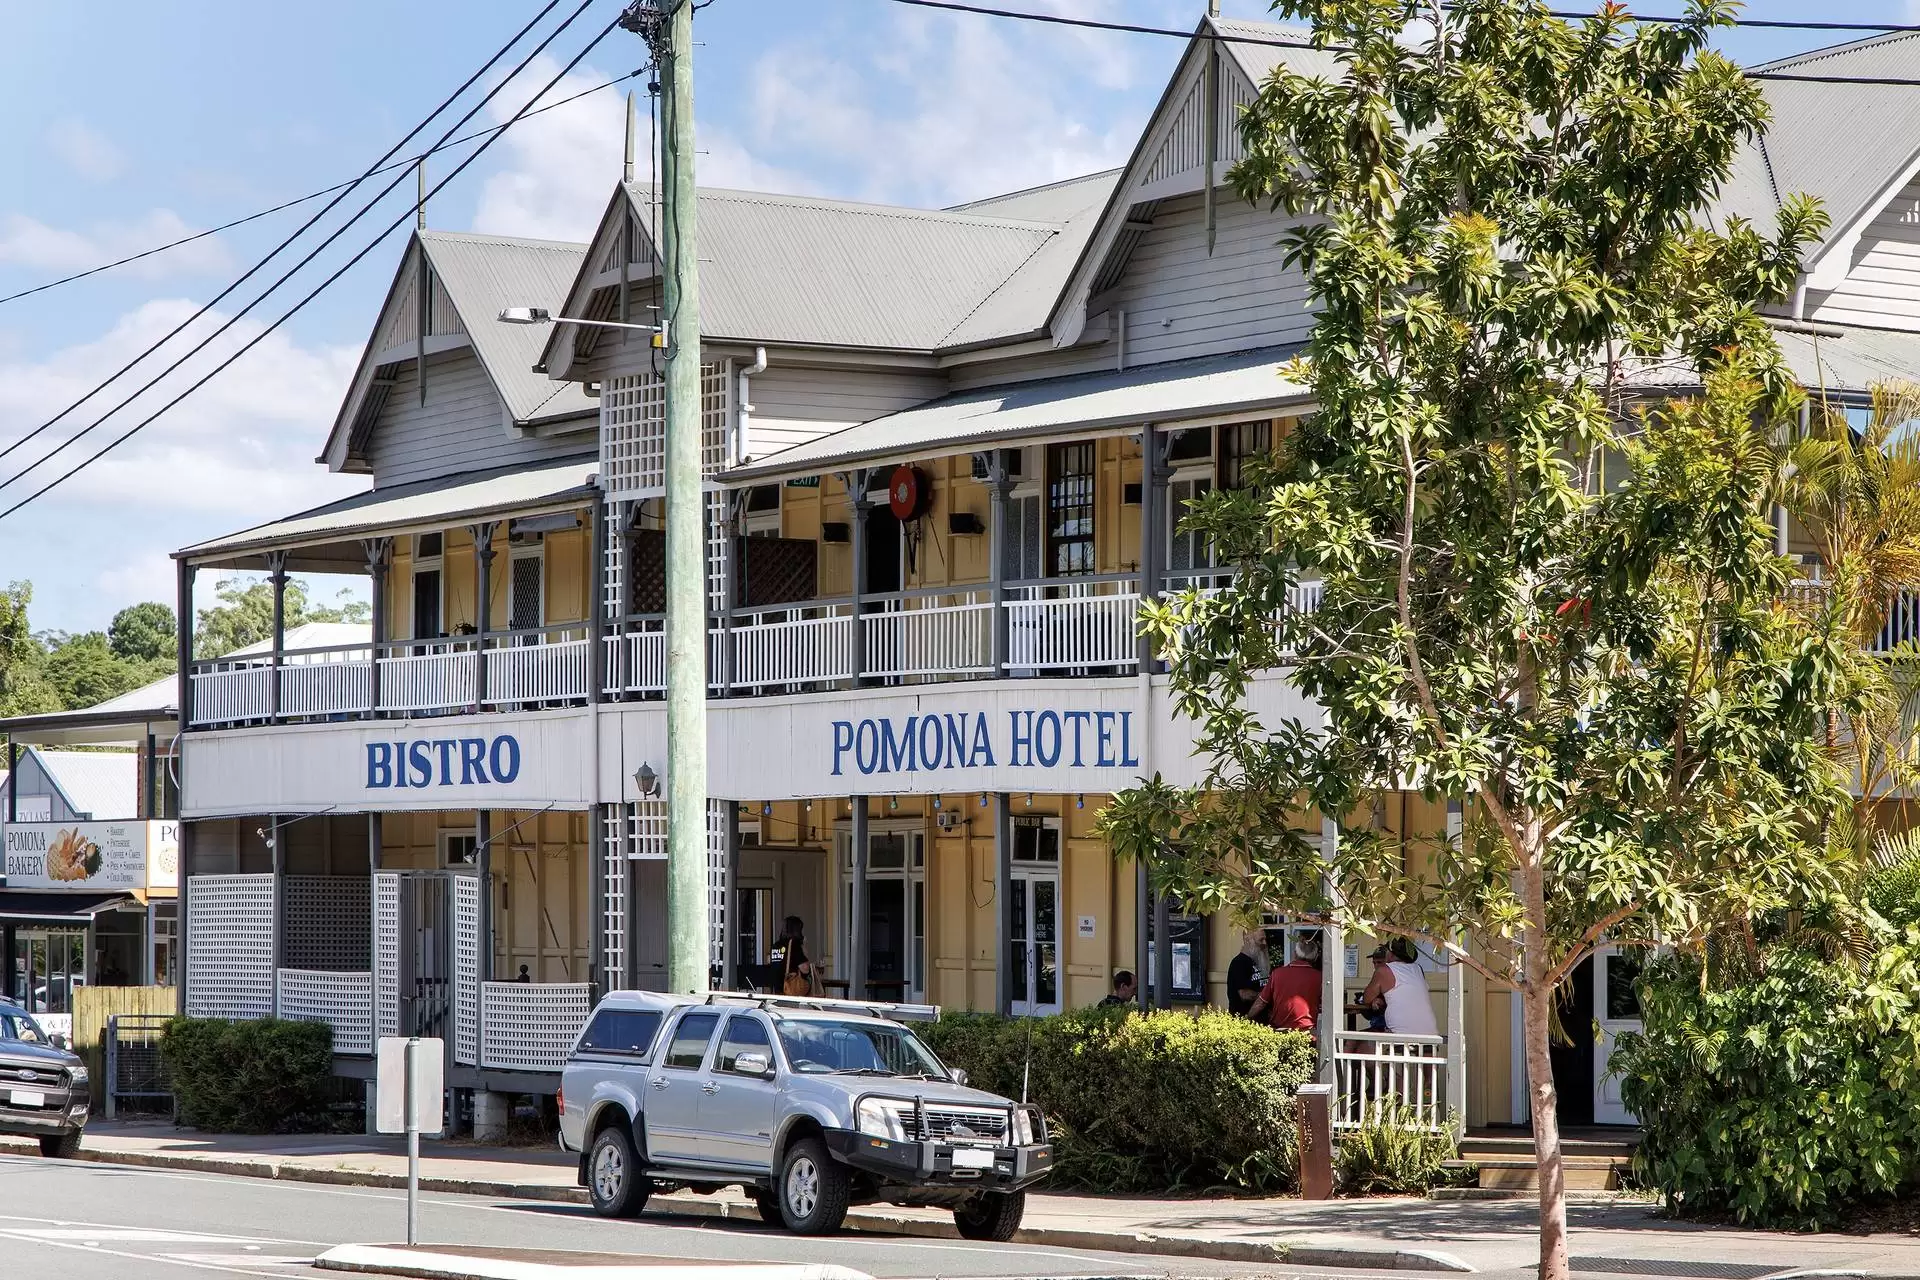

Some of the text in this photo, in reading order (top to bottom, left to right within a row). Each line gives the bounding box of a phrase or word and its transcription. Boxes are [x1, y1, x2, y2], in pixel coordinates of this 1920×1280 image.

[365, 734, 521, 788] BISTRO
[831, 710, 1139, 776] POMONA HOTEL
[8, 831, 46, 851] POMONA
[8, 854, 46, 876] BAKERY
